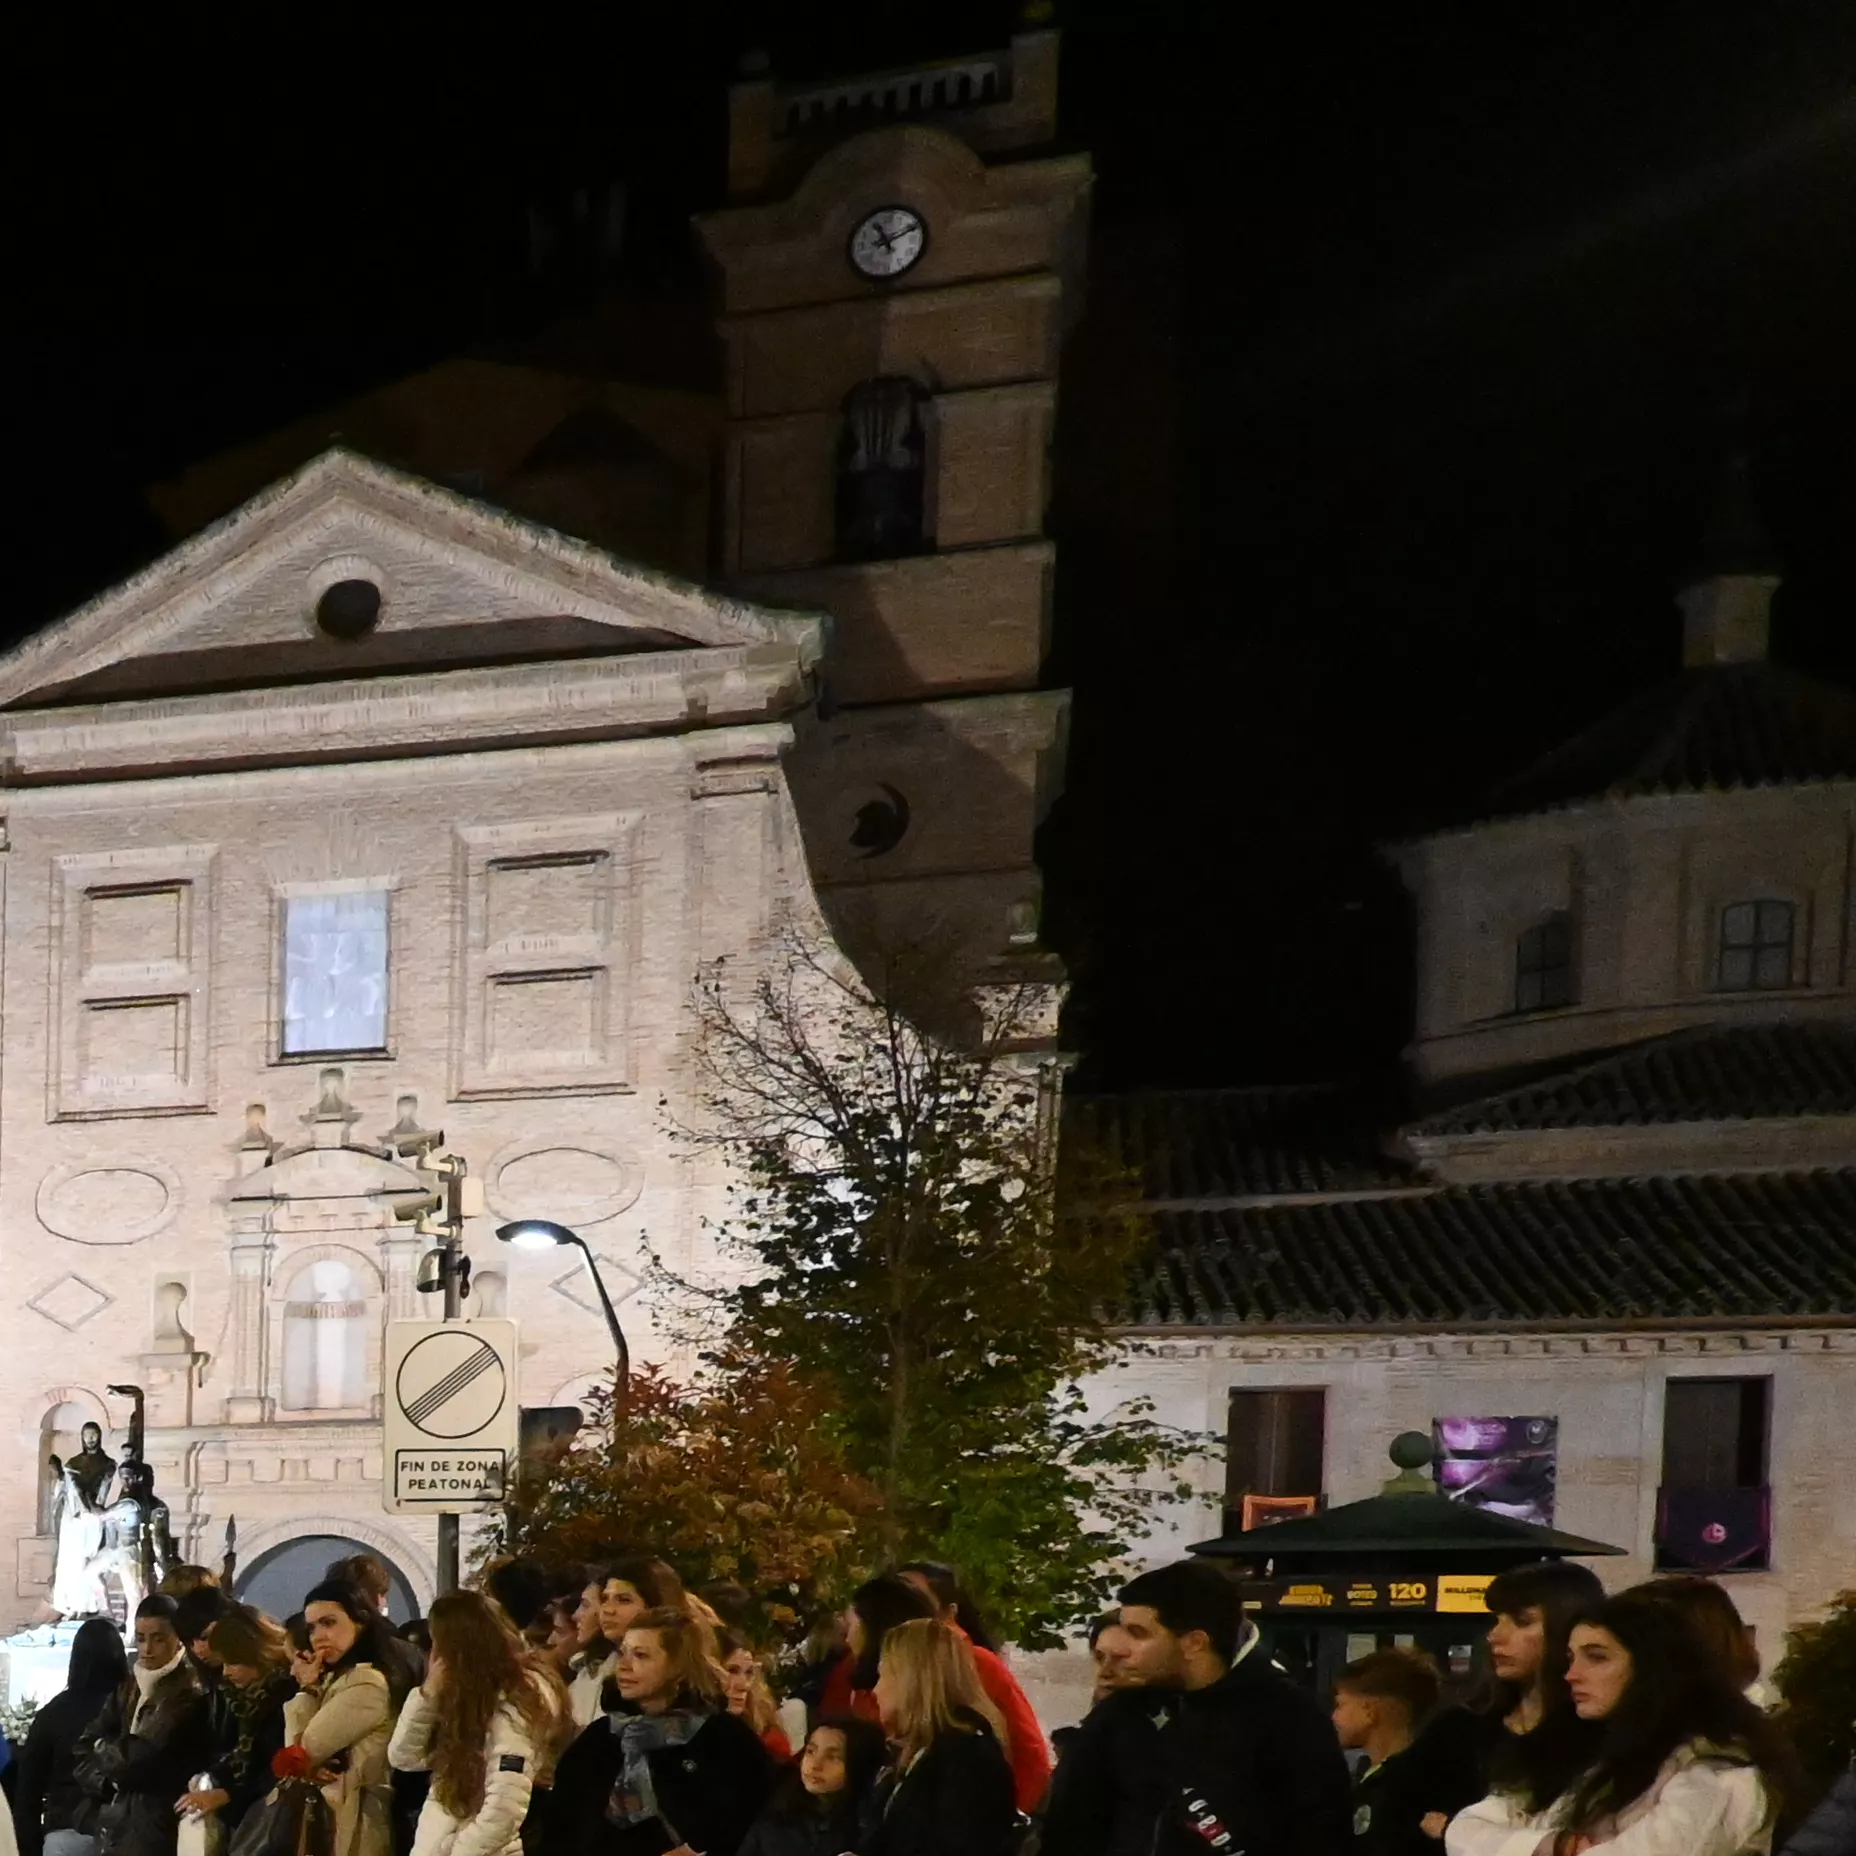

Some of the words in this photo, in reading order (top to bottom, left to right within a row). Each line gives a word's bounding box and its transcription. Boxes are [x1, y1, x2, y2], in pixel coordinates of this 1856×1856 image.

[400, 1461, 425, 1472] FIN
[430, 1461, 451, 1472] DE
[456, 1461, 500, 1472] ZONA
[408, 1479, 491, 1490] PEATONAL
[1389, 1583, 1428, 1600] 120
